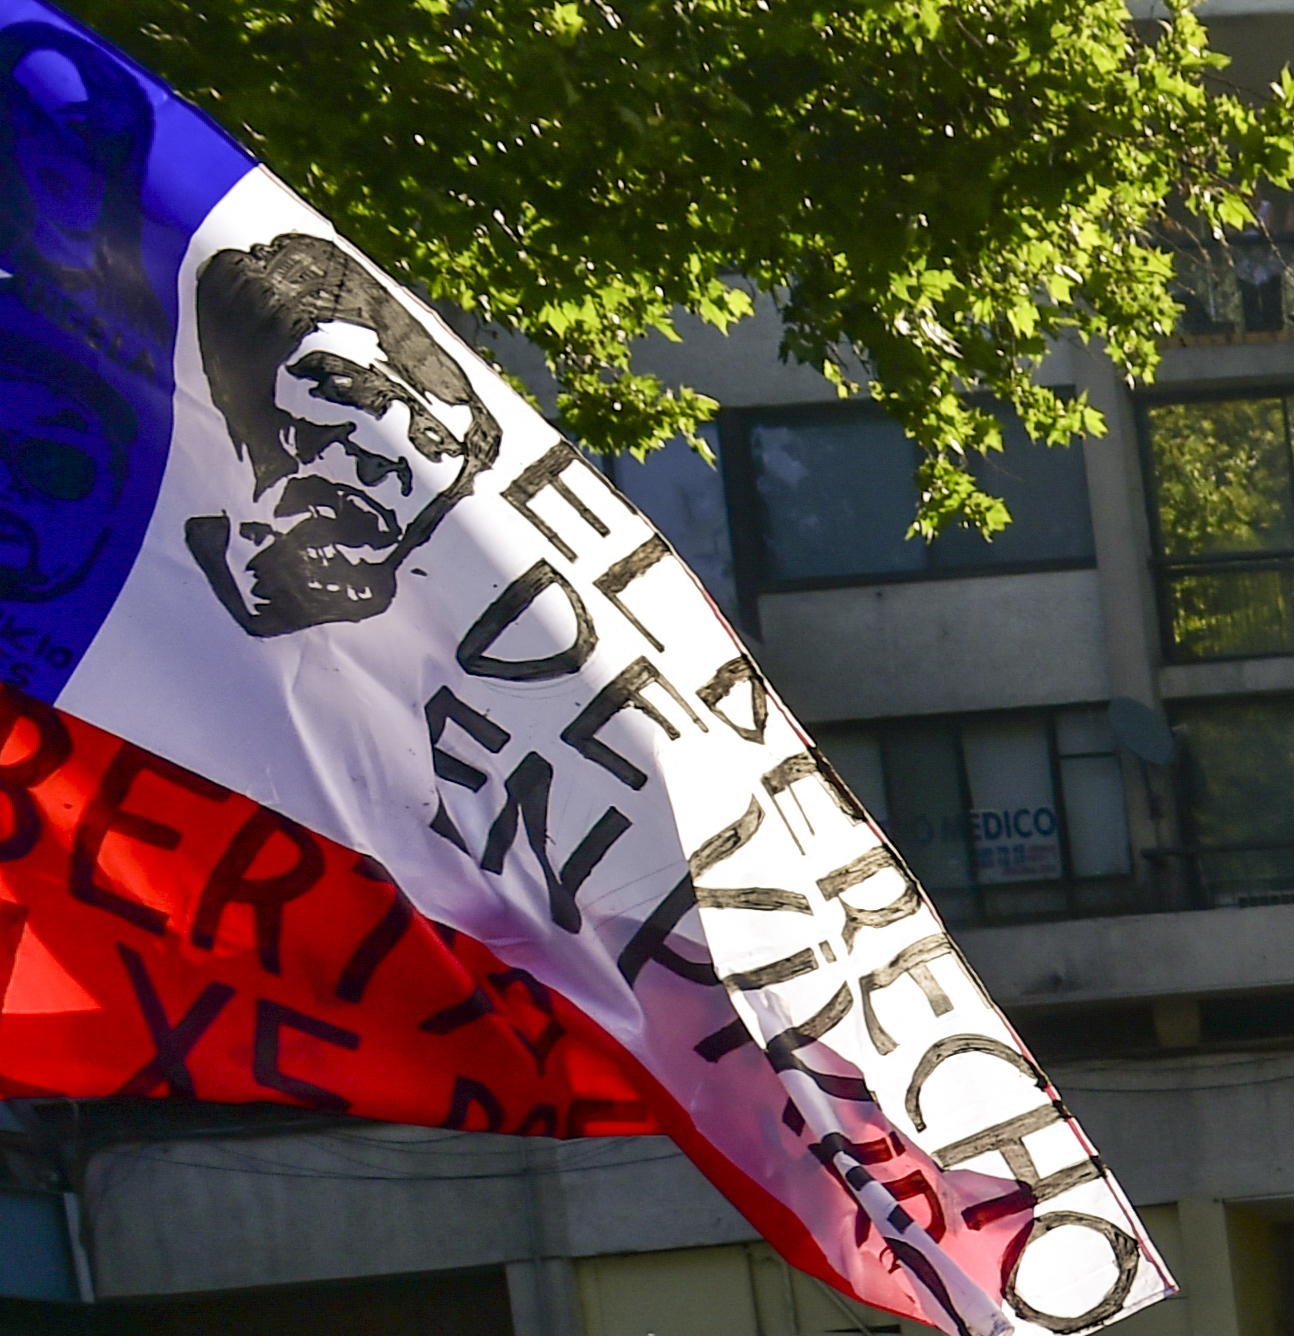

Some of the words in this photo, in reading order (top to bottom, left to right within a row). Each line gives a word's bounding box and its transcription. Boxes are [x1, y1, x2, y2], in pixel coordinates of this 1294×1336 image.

[456, 558, 709, 790] DE
[424, 685, 633, 933] EN
[501, 439, 671, 652] EL
[696, 654, 1139, 1334] DERECHO
